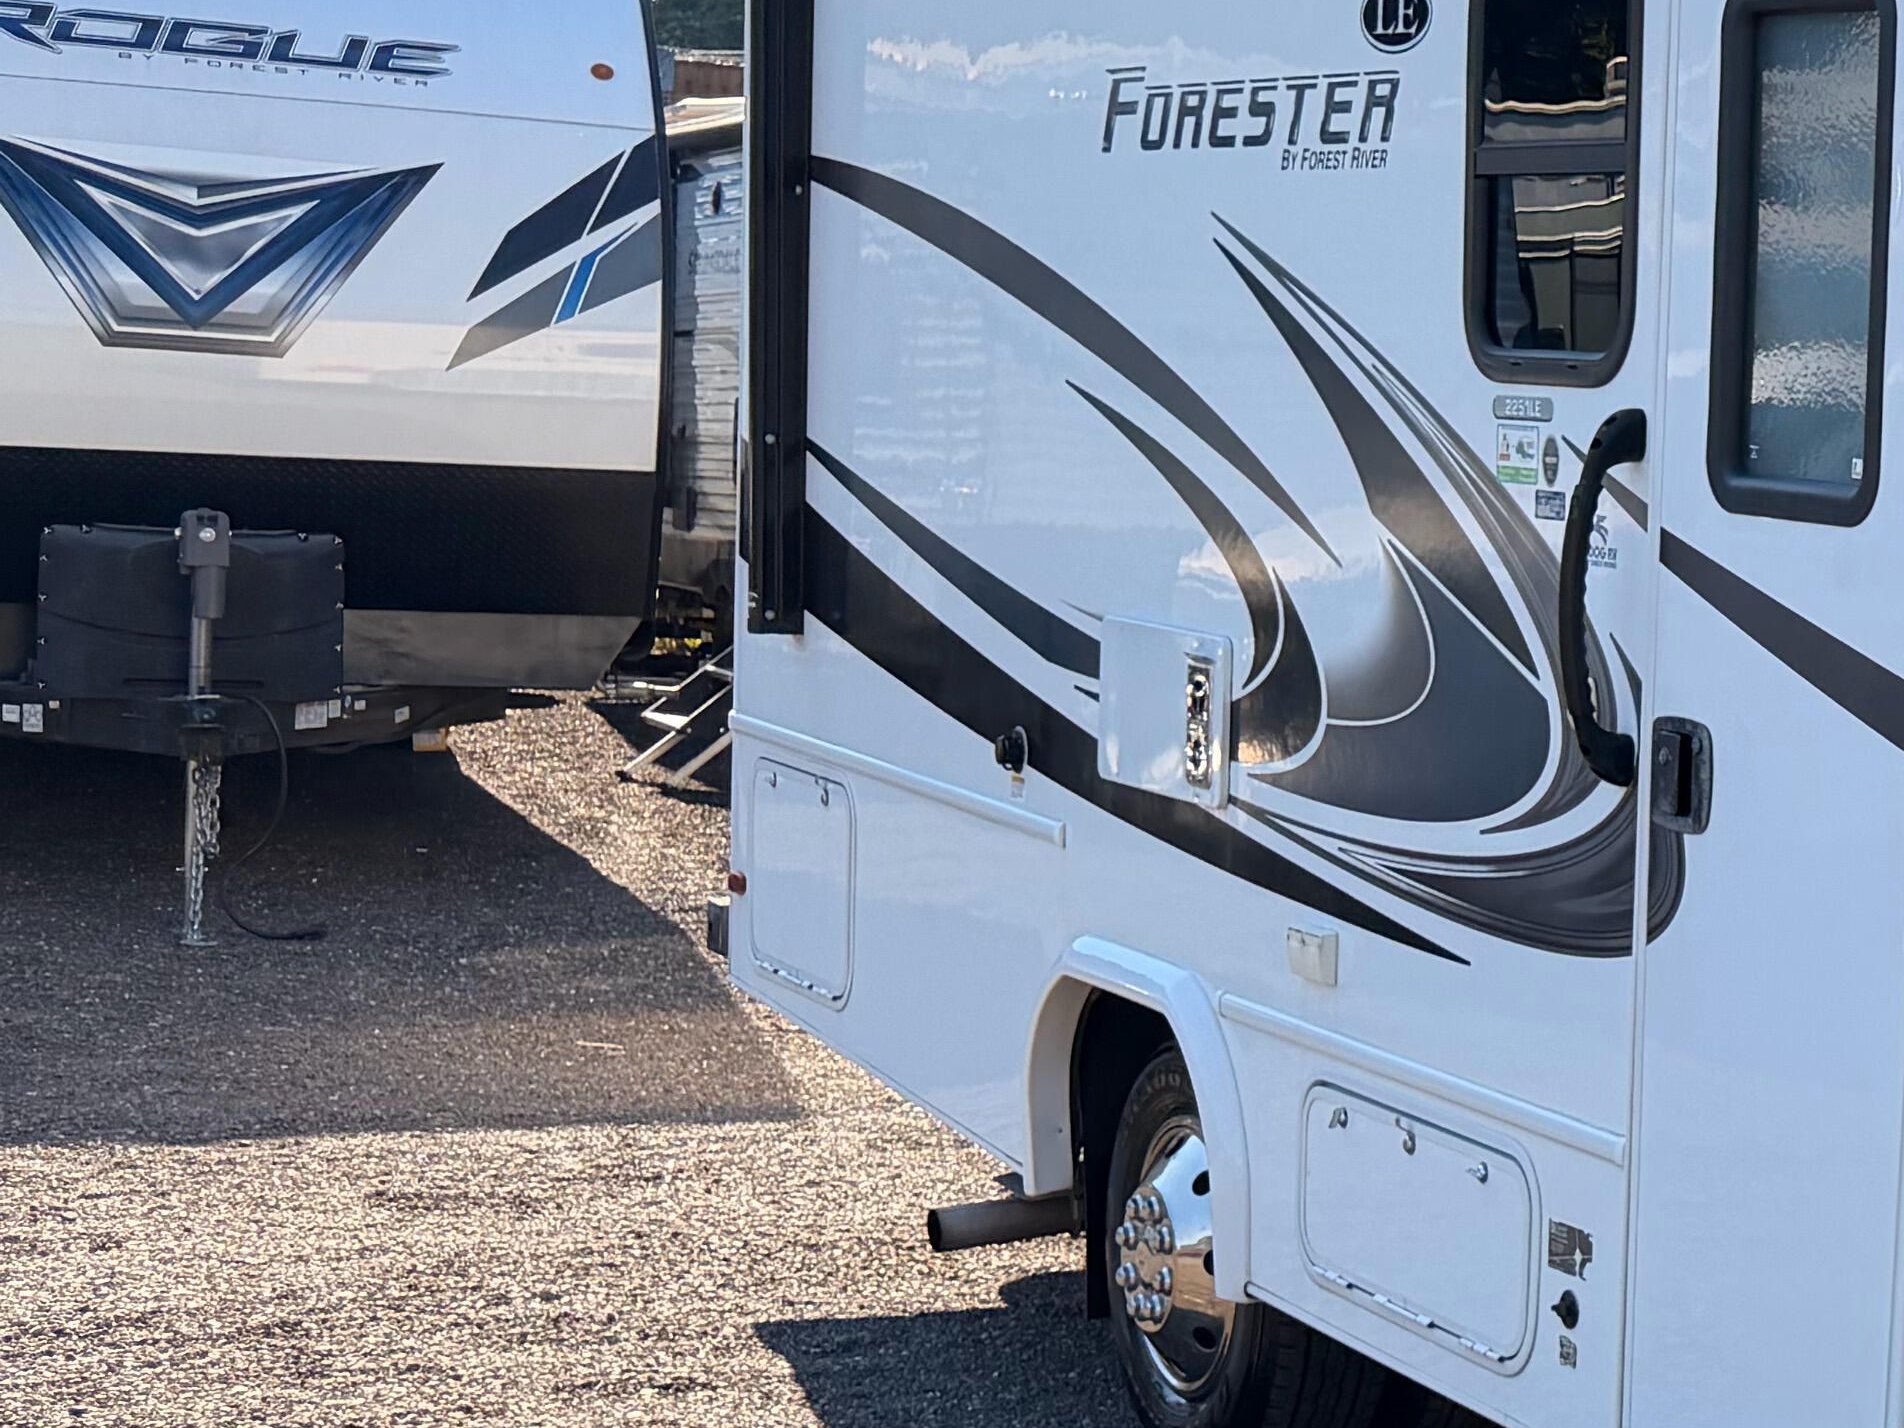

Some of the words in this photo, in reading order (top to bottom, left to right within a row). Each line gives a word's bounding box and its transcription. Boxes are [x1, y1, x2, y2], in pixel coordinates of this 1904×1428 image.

[183, 56, 309, 76] FOREST
[338, 71, 428, 88] RIVER
[1101, 66, 1401, 154] FORESTER
[1280, 148, 1299, 172] BY
[1300, 147, 1349, 171] FOREST
[1350, 146, 1389, 170] RIVER
